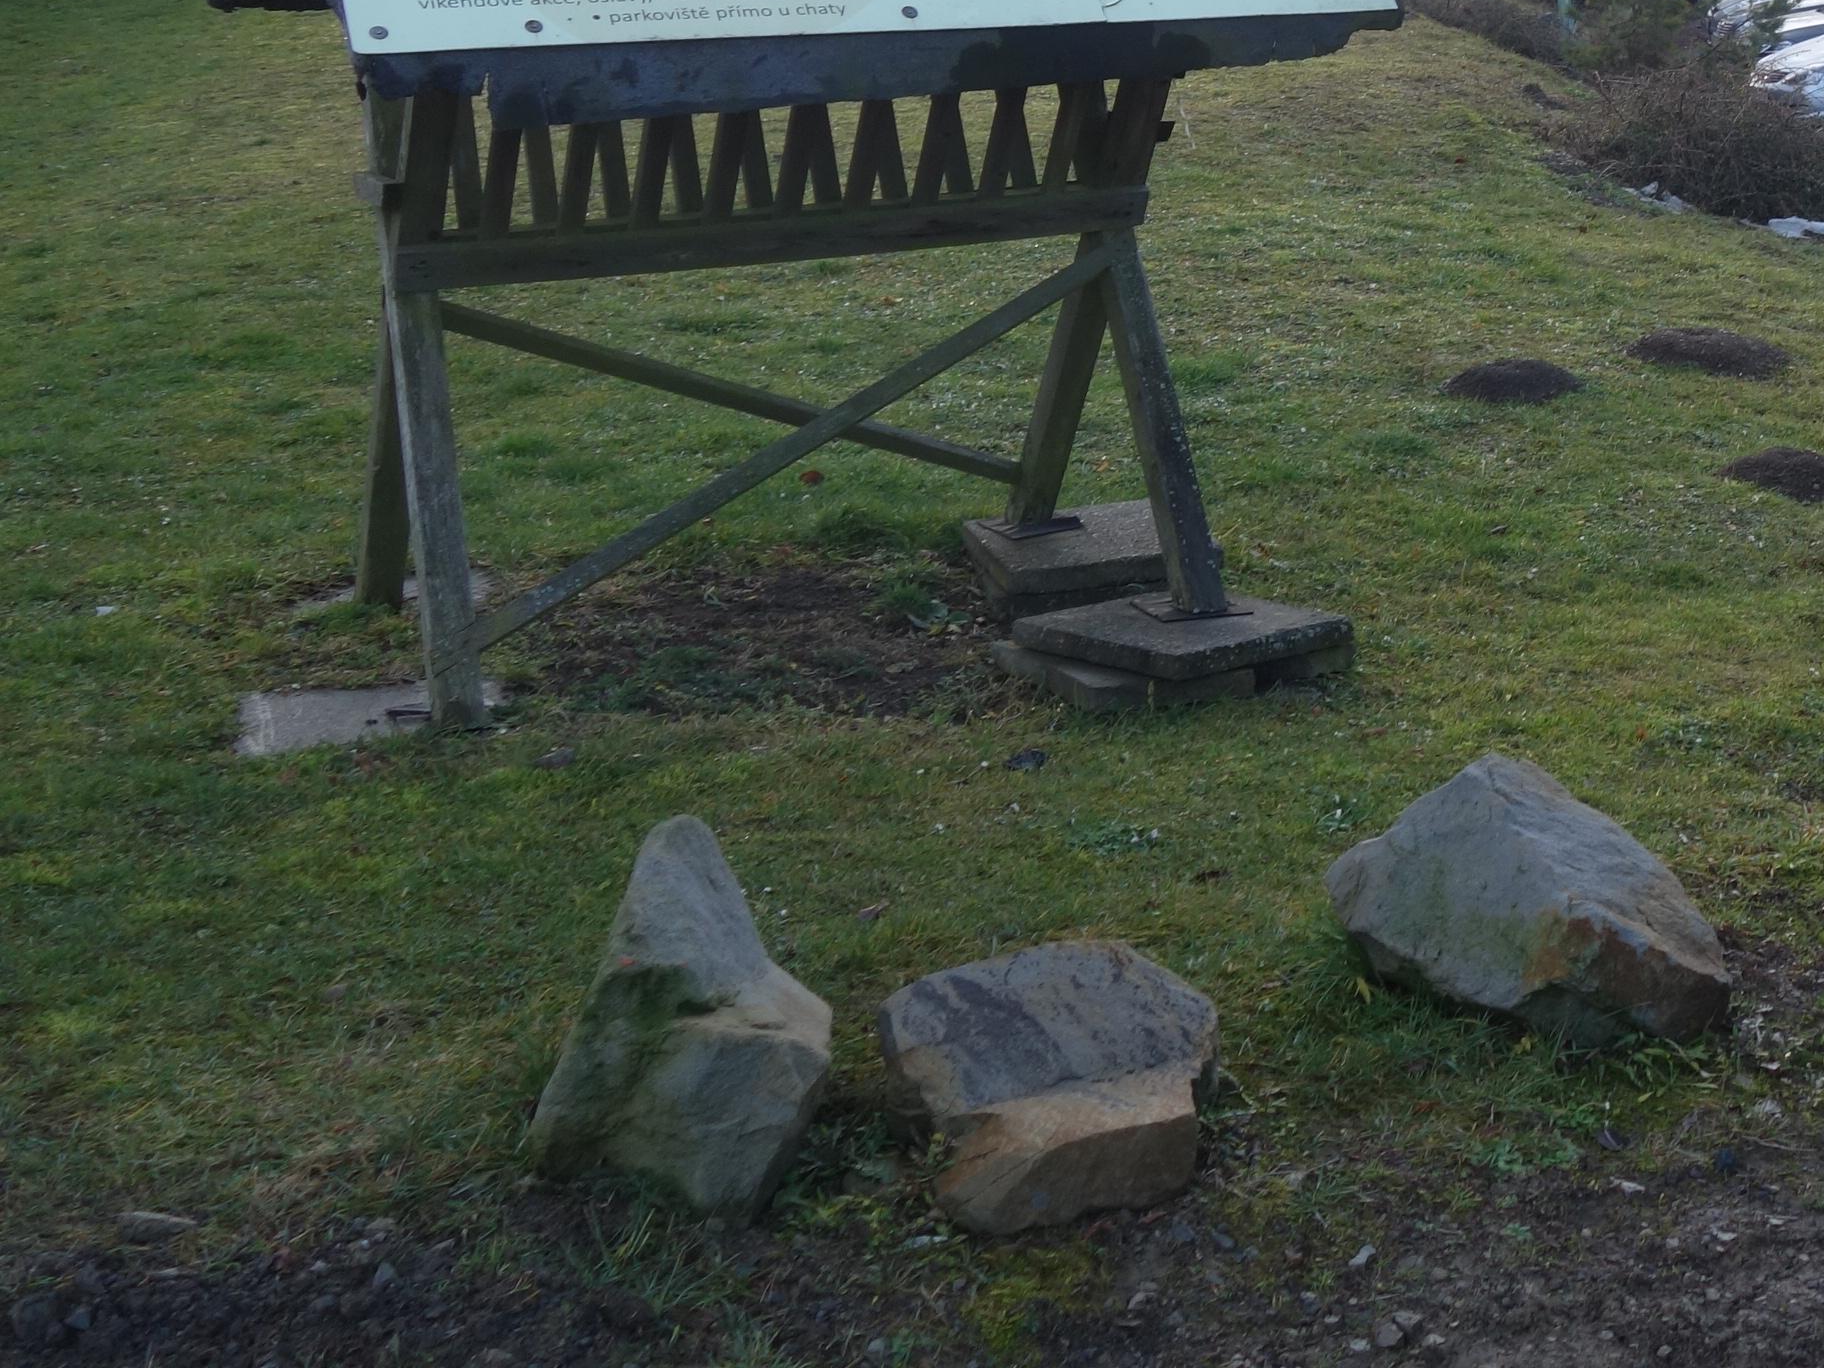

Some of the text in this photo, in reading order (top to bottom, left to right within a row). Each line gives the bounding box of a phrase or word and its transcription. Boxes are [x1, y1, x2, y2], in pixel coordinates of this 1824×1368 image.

[609, 3, 846, 25] parkoviště přímo u chaty
